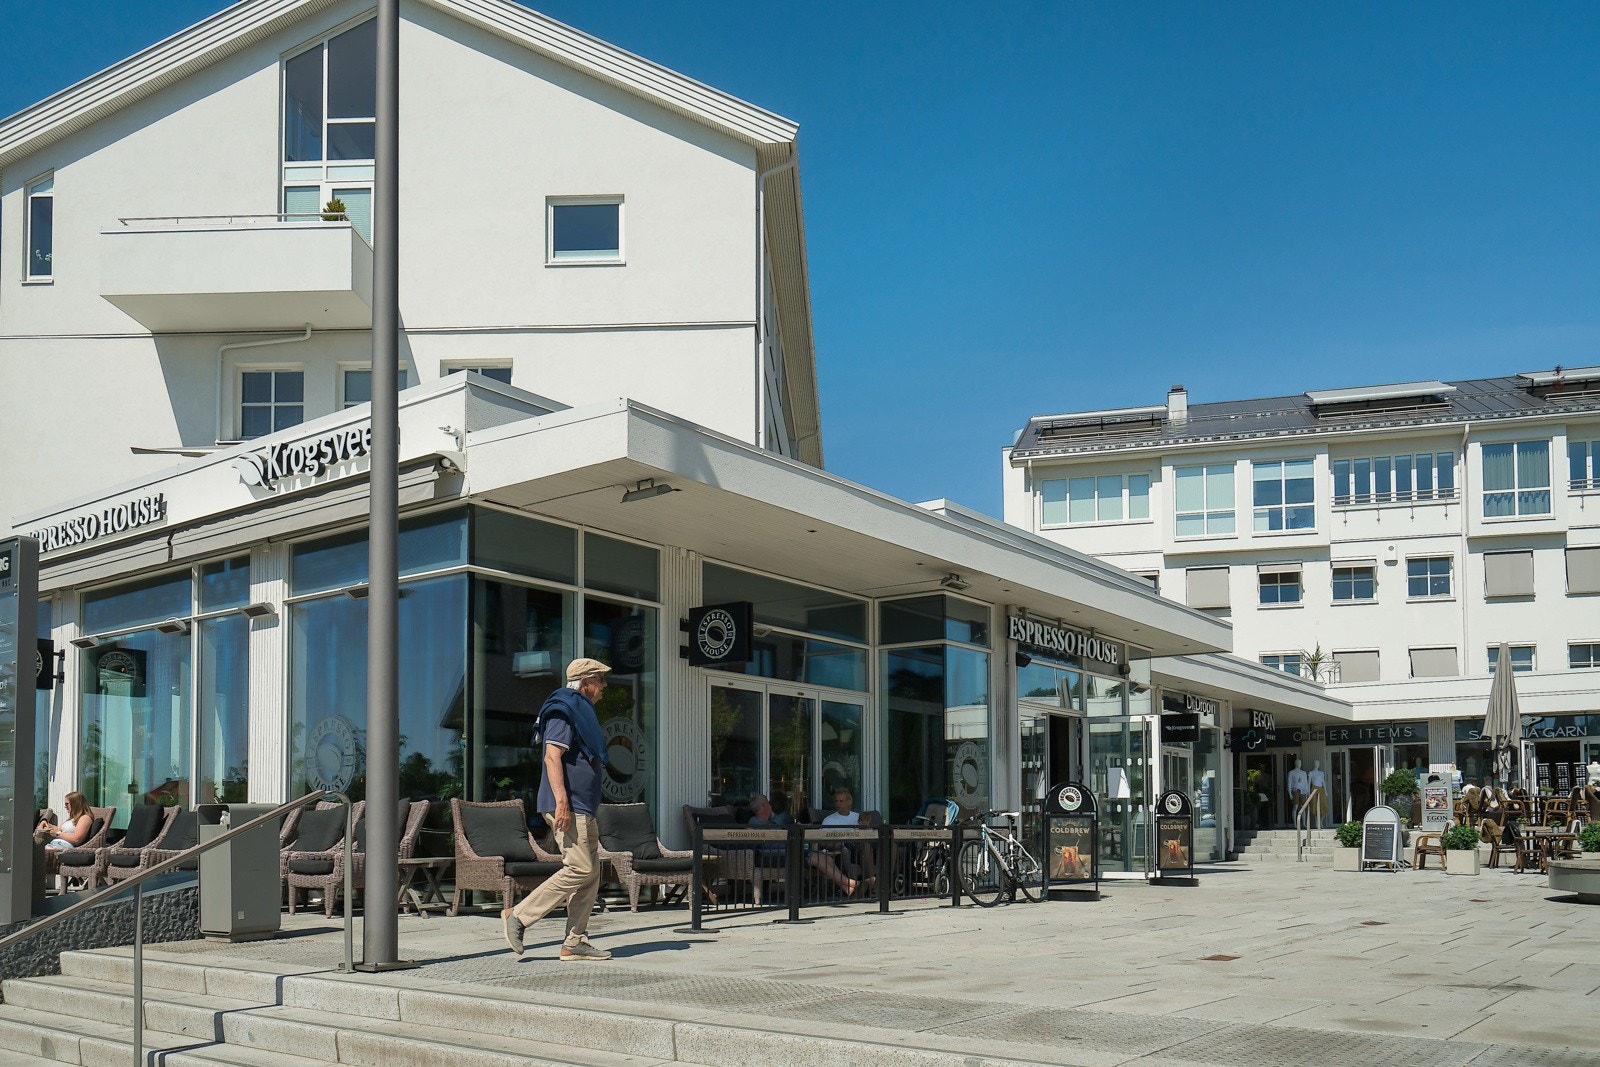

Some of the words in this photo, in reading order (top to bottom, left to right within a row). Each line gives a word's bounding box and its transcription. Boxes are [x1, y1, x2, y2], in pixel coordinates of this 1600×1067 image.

[267, 427, 371, 479] Krogsvee
[29, 514, 99, 553] PRESSO
[99, 495, 161, 536] HOUSE
[701, 613, 731, 631] ESPRESSO
[704, 643, 728, 655] HOUSE
[1009, 616, 1076, 653] ESPRESSO
[1077, 634, 1118, 664] HOUSE
[1253, 711, 1275, 731] EGON
[1292, 729, 1349, 742] OTHER
[1360, 726, 1412, 739] ITEMS
[1542, 726, 1587, 738] GARN
